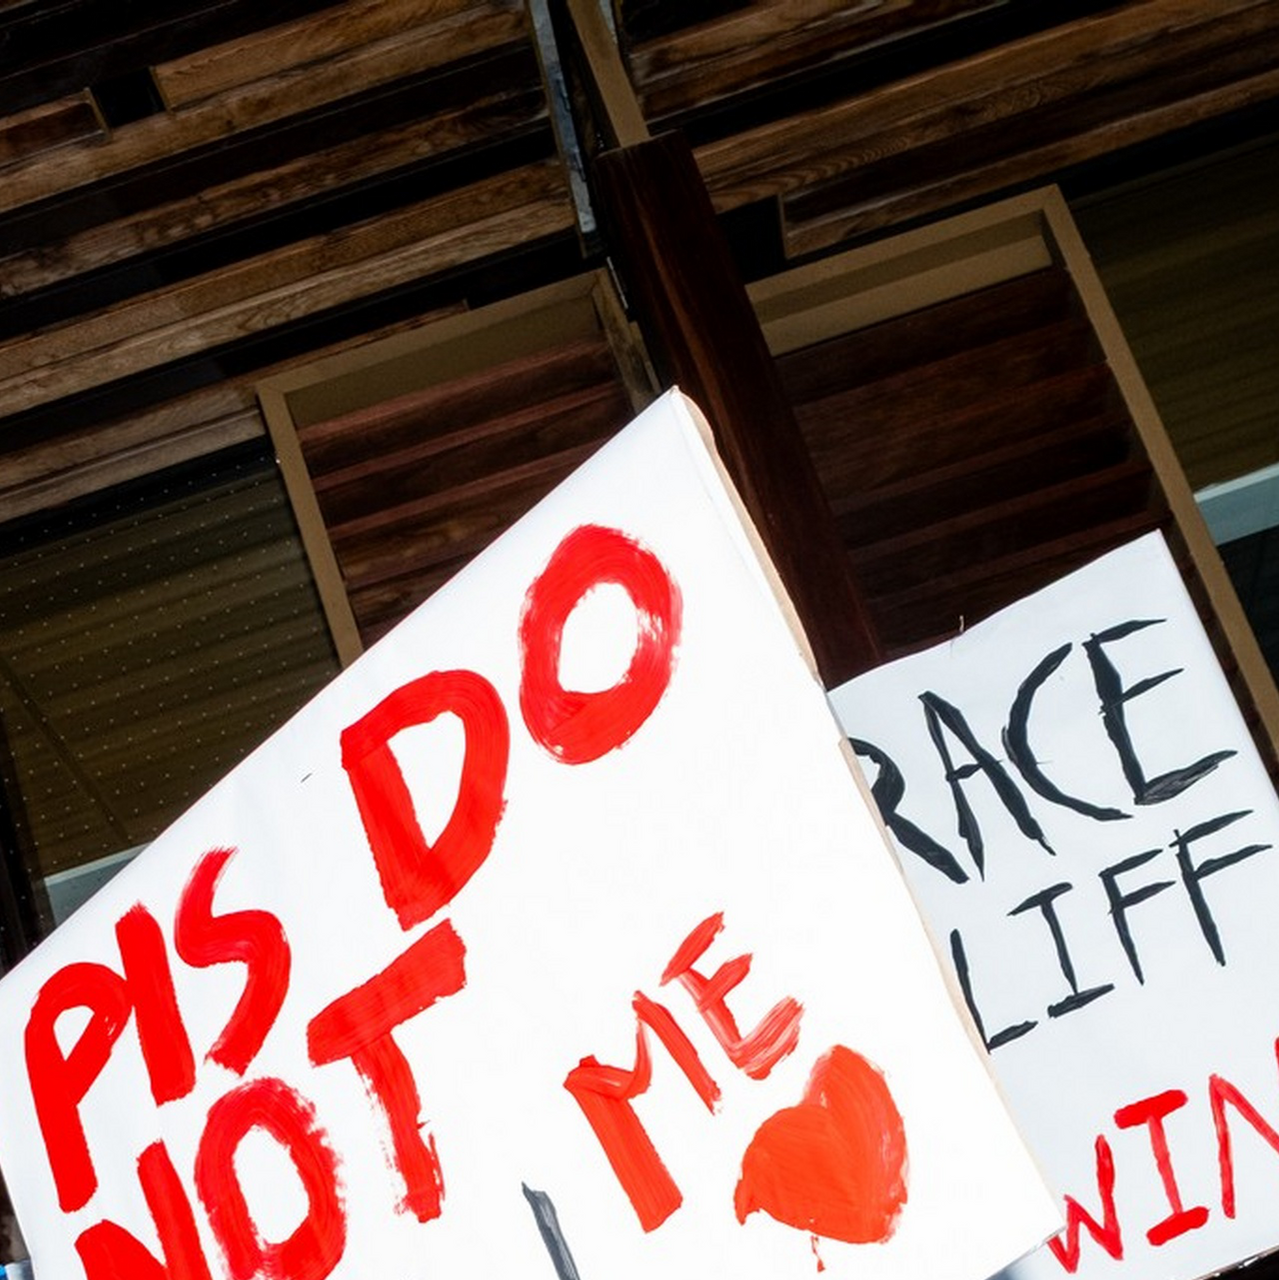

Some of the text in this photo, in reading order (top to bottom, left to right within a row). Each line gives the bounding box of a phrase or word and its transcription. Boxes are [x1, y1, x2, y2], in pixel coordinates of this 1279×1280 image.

[341, 523, 684, 931] DO
[848, 618, 1238, 885] RACE
[563, 910, 805, 1233] ME
